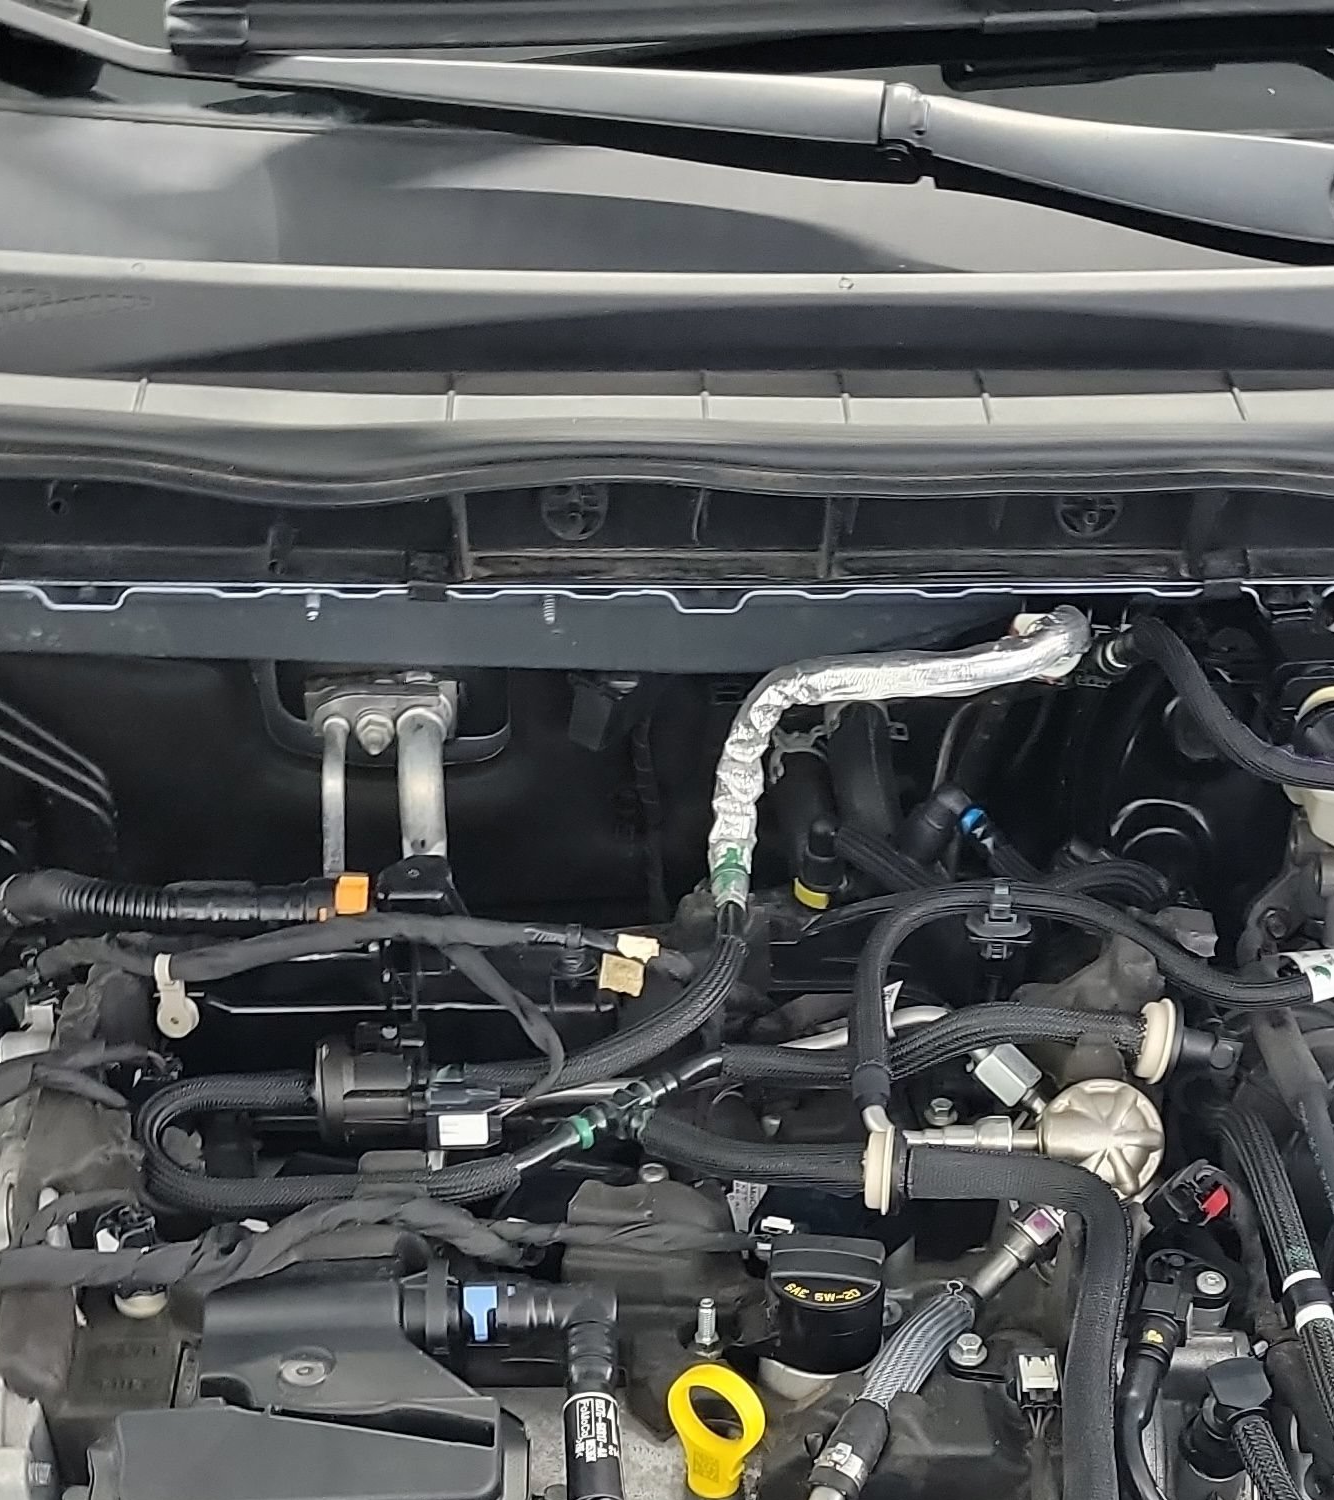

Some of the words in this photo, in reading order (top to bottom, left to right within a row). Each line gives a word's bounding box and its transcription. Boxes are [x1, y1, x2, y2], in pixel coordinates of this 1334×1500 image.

[783, 1282, 810, 1299] SAE
[814, 1288, 861, 1302] 5W-20
[579, 1400, 591, 1437] FoMoCo
